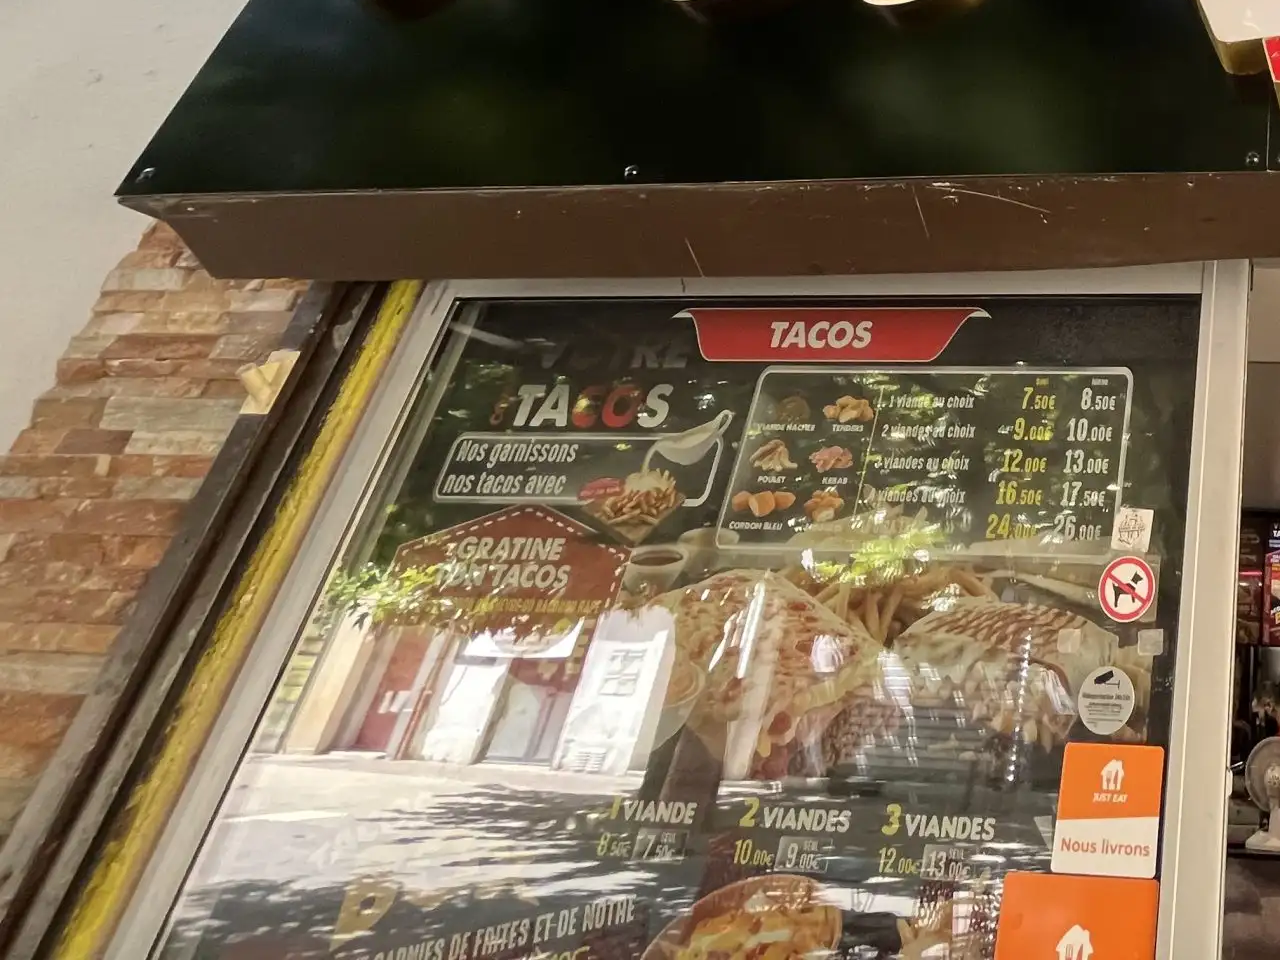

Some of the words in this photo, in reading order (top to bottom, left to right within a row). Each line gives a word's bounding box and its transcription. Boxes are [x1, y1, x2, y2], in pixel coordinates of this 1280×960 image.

[769, 320, 874, 349] TACOS
[511, 384, 675, 429] TACOS
[947, 394, 976, 409] choix
[1022, 387, 1057, 410] 7.50€
[1081, 387, 1117, 411] 8.50€
[881, 424, 890, 438] 2
[947, 424, 976, 438] choix
[1014, 418, 1053, 441] 9.00€
[1066, 418, 1113, 442] 10.00€
[455, 440, 486, 462] Nos
[487, 439, 580, 469] garnissons
[884, 455, 924, 470] viandes
[941, 455, 971, 470] choix
[1001, 448, 1047, 473] 12.00€
[1063, 449, 1109, 474] 13.00€
[442, 474, 475, 494] nos
[479, 473, 523, 494] tacos
[525, 475, 568, 495] avec
[996, 480, 1042, 506] 16.50€
[1060, 481, 1106, 507] 17.50€
[1053, 515, 1102, 541] 26.00€
[456, 535, 567, 561] GRATINE
[491, 563, 571, 590] TACOS
[1093, 792, 1111, 803] JUST
[1112, 794, 1129, 803] EAT
[622, 800, 698, 825] VIANDE
[739, 797, 761, 828] 2
[763, 806, 852, 833] VIANDES
[881, 803, 902, 836] 3
[905, 814, 997, 841] VIANDES
[733, 839, 775, 866] 10.00€
[1061, 838, 1098, 854] Nous
[1101, 838, 1151, 857] livrons
[450, 932, 472, 959] DE
[472, 918, 531, 958] FRITES
[533, 912, 555, 944] ET
[556, 906, 580, 938] DE
